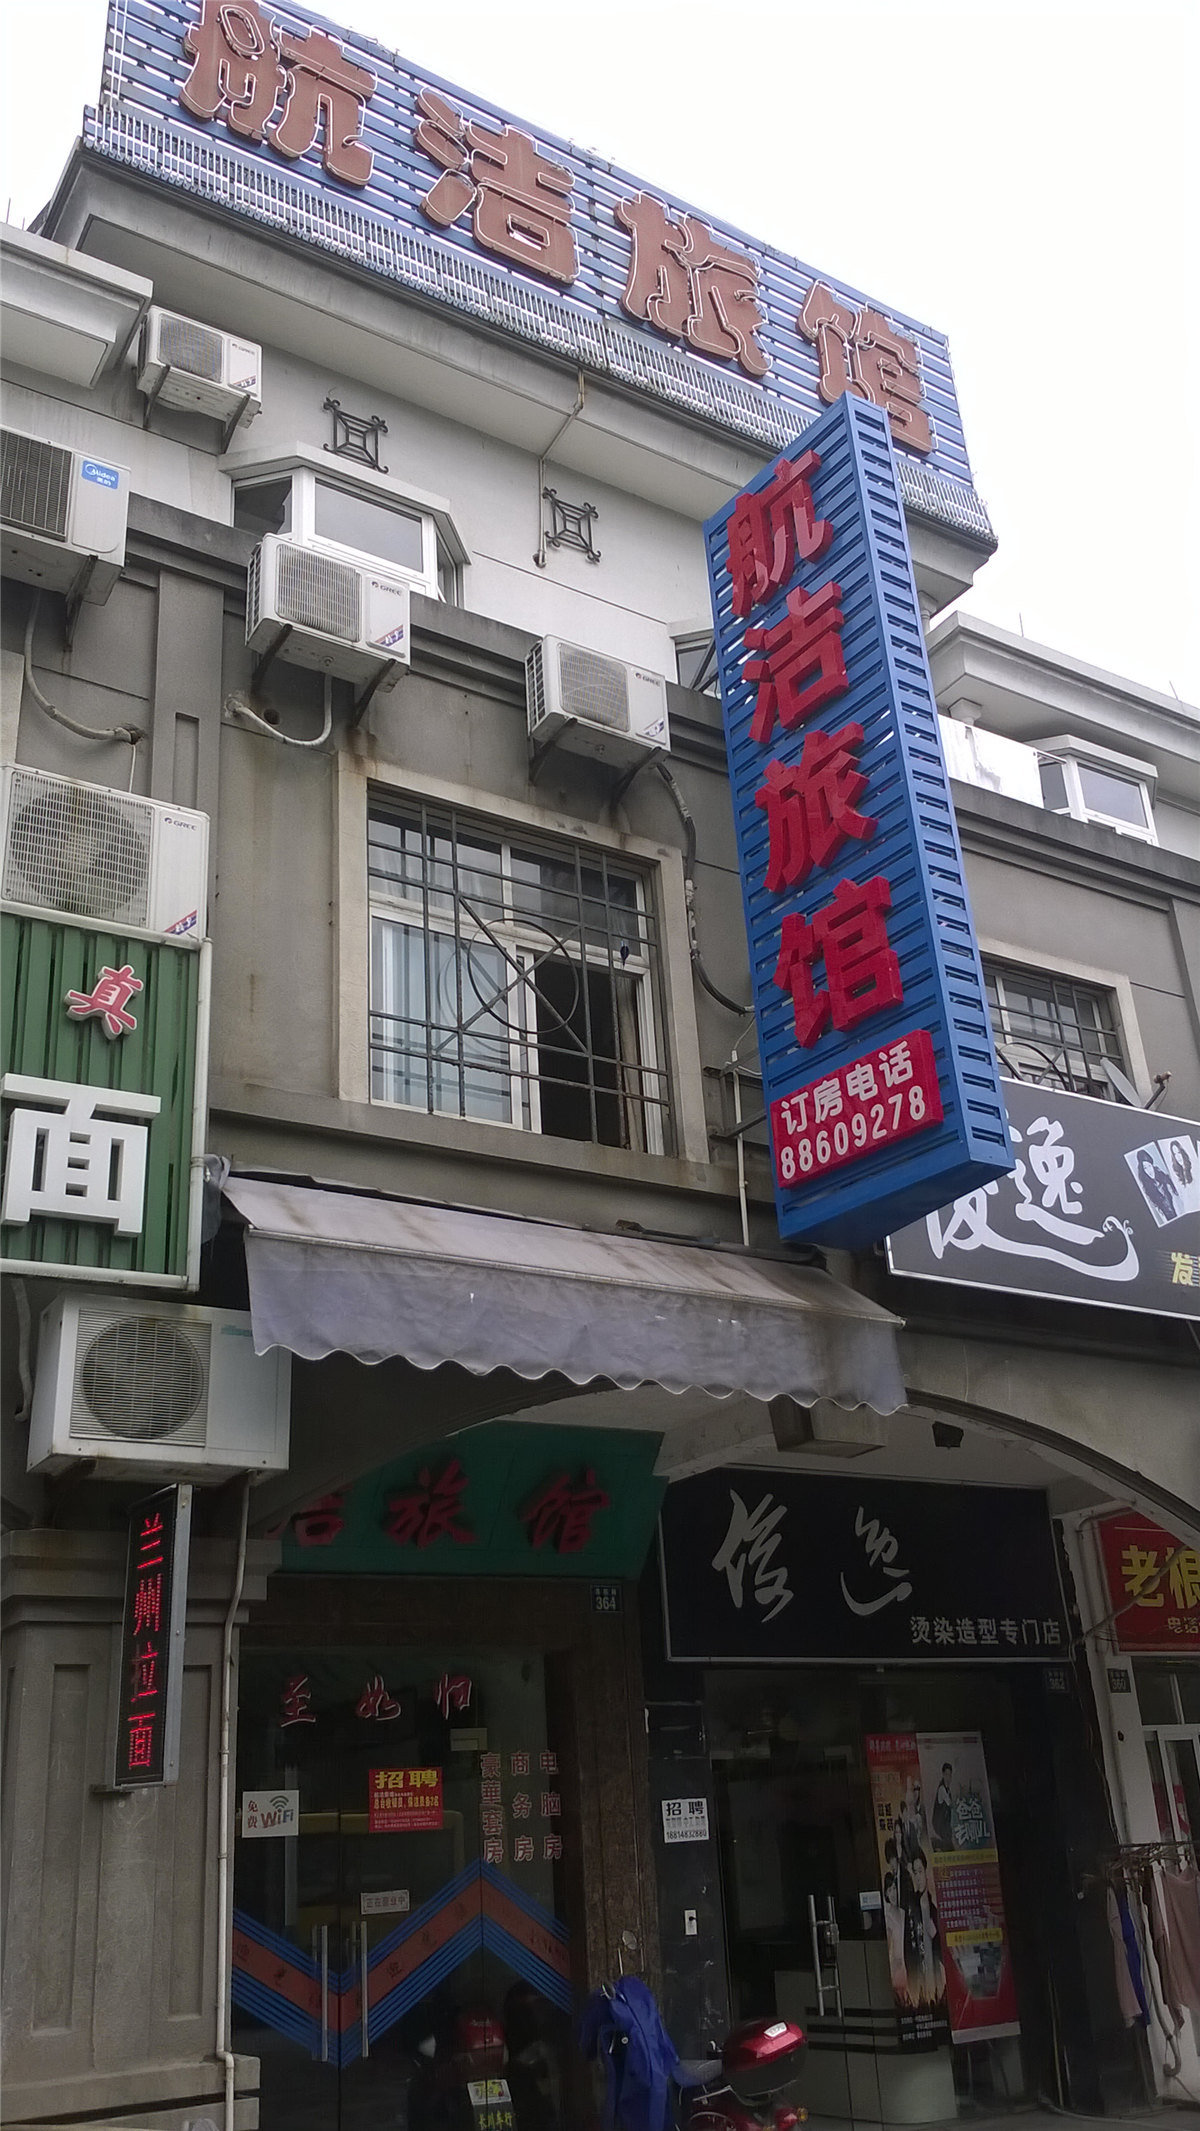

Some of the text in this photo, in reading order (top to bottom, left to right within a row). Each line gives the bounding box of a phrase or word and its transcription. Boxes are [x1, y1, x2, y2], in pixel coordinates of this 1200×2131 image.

[180, 0, 939, 457] 航洁旅馆
[725, 449, 904, 1048] 航洁旅馆
[173, 820, 198, 831] GREE
[65, 964, 143, 1038] 真
[780, 1040, 913, 1135] 订房电话
[0, 1072, 162, 1238] 面
[780, 1085, 926, 1180] 88609278
[595, 1596, 617, 1611] 364
[909, 1615, 1062, 1646] 烫染造型专门店
[247, 1800, 258, 1829] 免费
[374, 1769, 439, 1789] 招聘
[510, 1748, 534, 1862] 商务房
[540, 1748, 563, 1860] 电脑房
[666, 1801, 704, 1816] 招聘
[260, 1808, 294, 1829] WiFi
